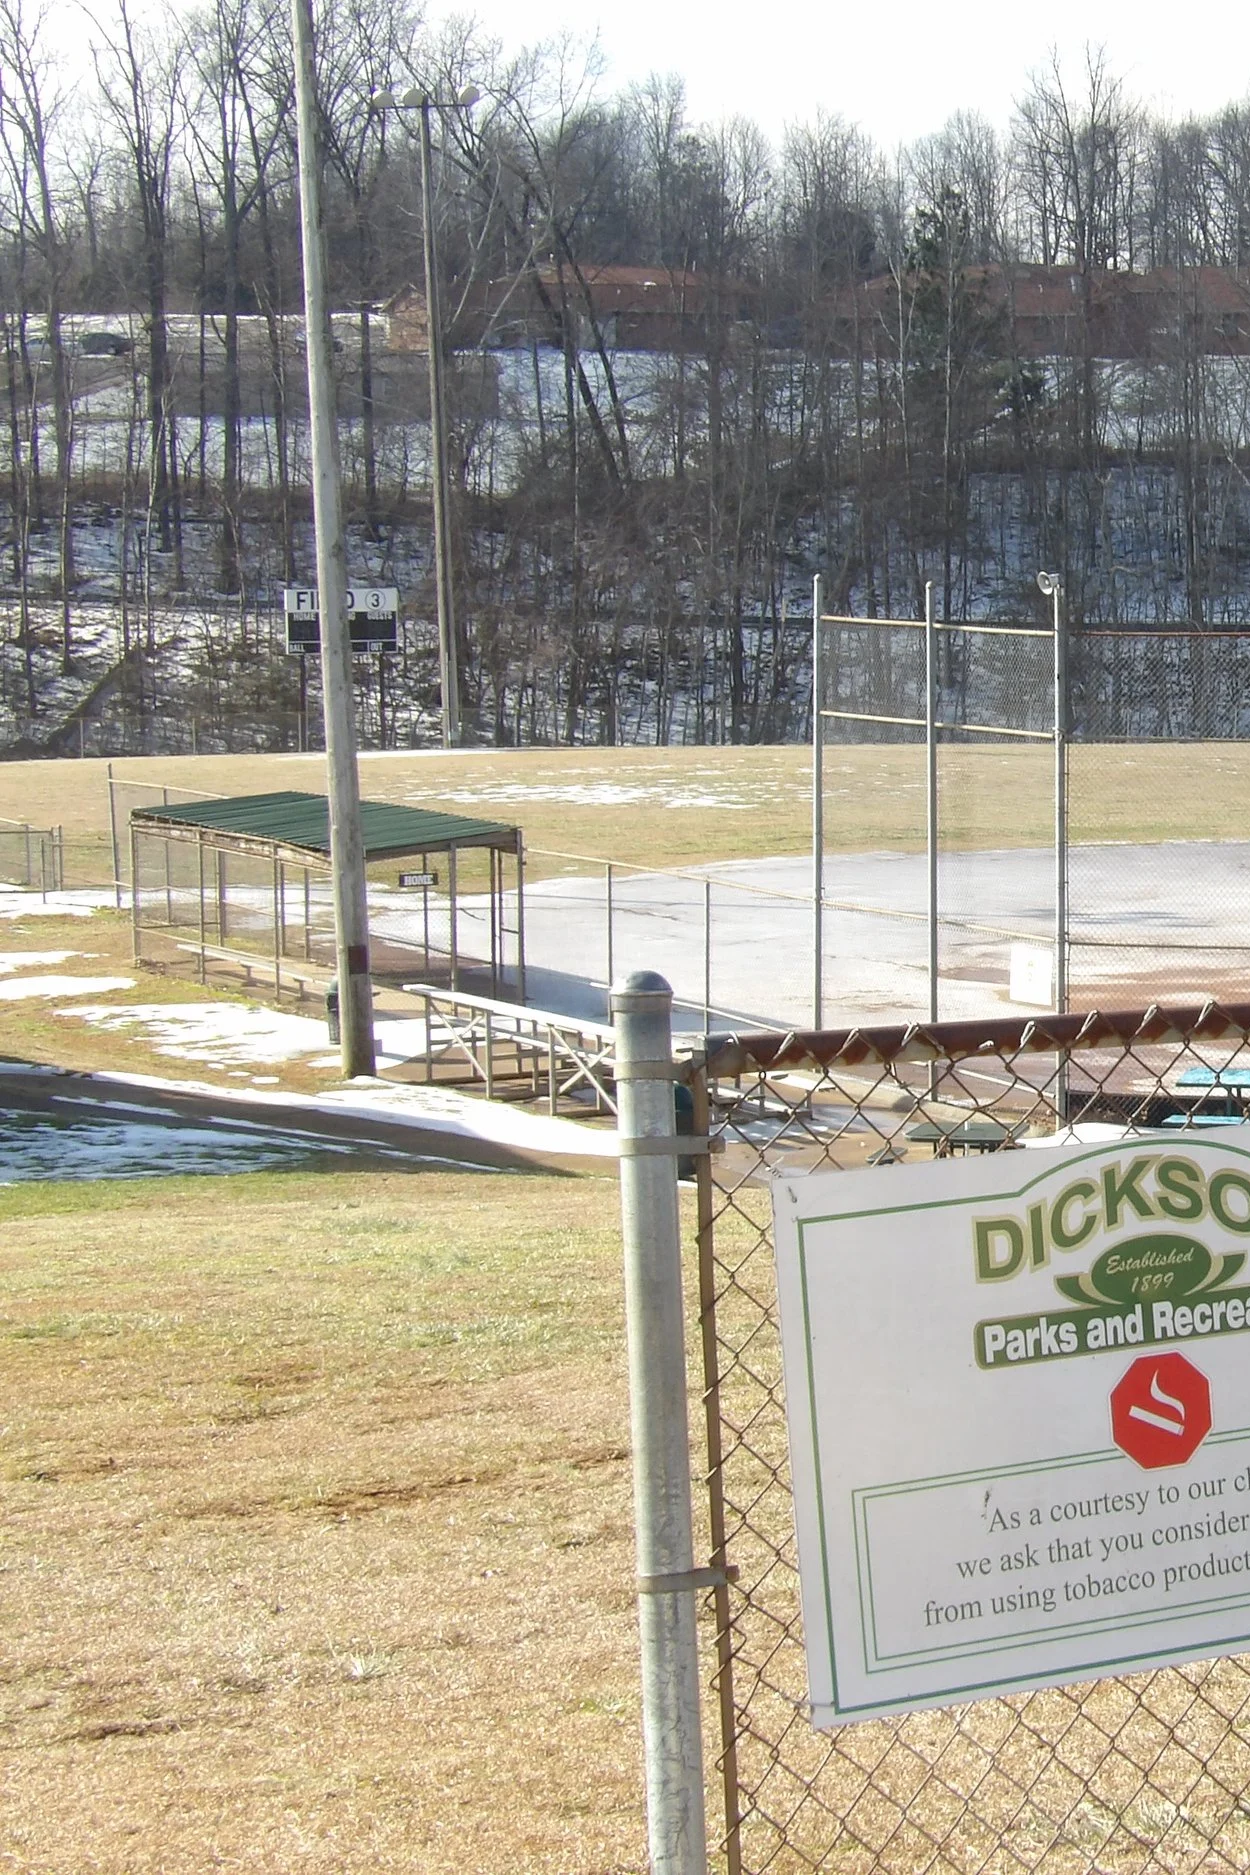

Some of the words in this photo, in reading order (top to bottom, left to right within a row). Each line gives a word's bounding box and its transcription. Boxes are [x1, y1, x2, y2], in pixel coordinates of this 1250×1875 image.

[297, 591, 355, 610] FID
[371, 593, 380, 608] 3
[293, 612, 317, 621] HOME
[367, 611, 392, 620] GUESTS
[370, 642, 383, 651] OUT
[403, 875, 434, 886] HOME
[1106, 1247, 1195, 1275] Established
[1131, 1272, 1174, 1294] 1899
[982, 1315, 1079, 1364] Parks
[1086, 1303, 1145, 1350] and
[988, 1507, 1022, 1533] As
[1029, 1510, 1042, 1526] a
[1050, 1489, 1149, 1524] courtesy
[1158, 1483, 1180, 1505] to
[1188, 1477, 1227, 1501] our
[957, 1556, 992, 1579] we
[1000, 1543, 1041, 1572] ask
[1048, 1537, 1092, 1565] that
[1100, 1531, 1144, 1562] you
[1151, 1511, 1250, 1546] consider
[923, 1600, 983, 1628] from
[991, 1585, 1056, 1613] using
[1064, 1573, 1155, 1602] tobacco
